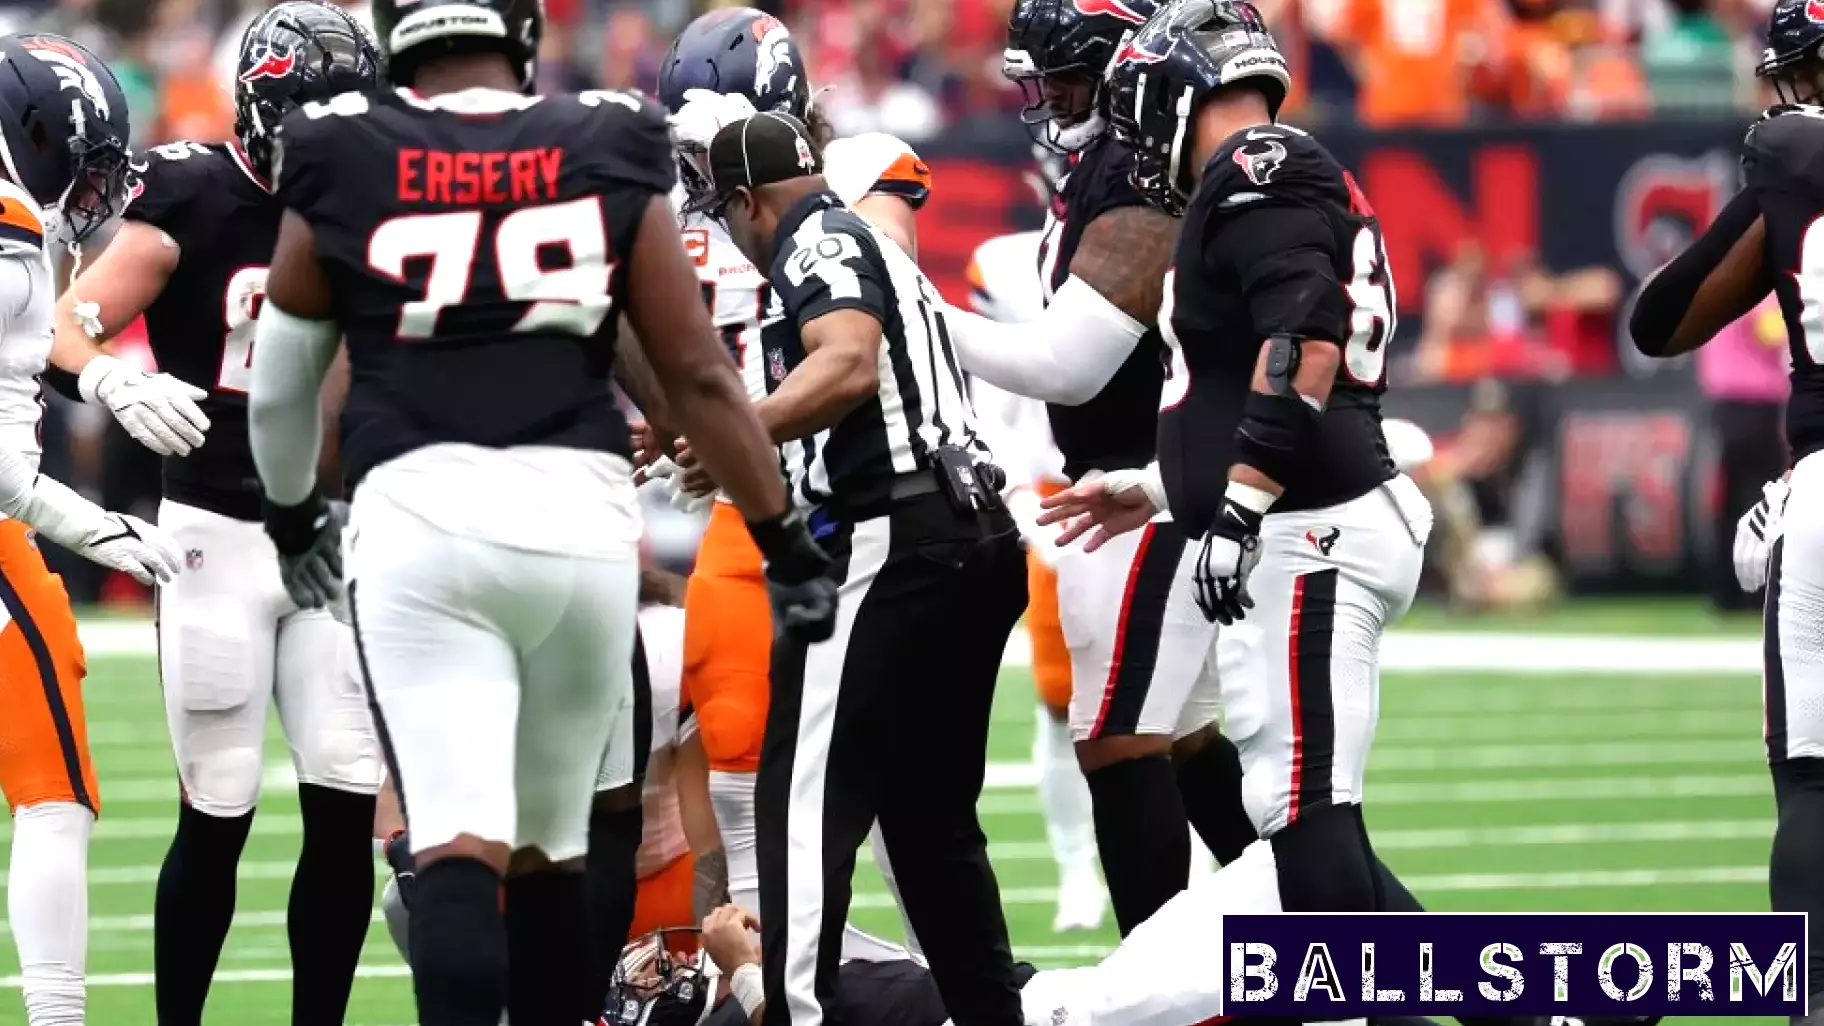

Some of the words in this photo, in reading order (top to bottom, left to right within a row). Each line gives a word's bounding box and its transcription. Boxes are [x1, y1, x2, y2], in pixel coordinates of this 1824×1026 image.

[397, 148, 562, 203] ERSERY
[368, 195, 621, 338] 79
[793, 236, 843, 275] 20
